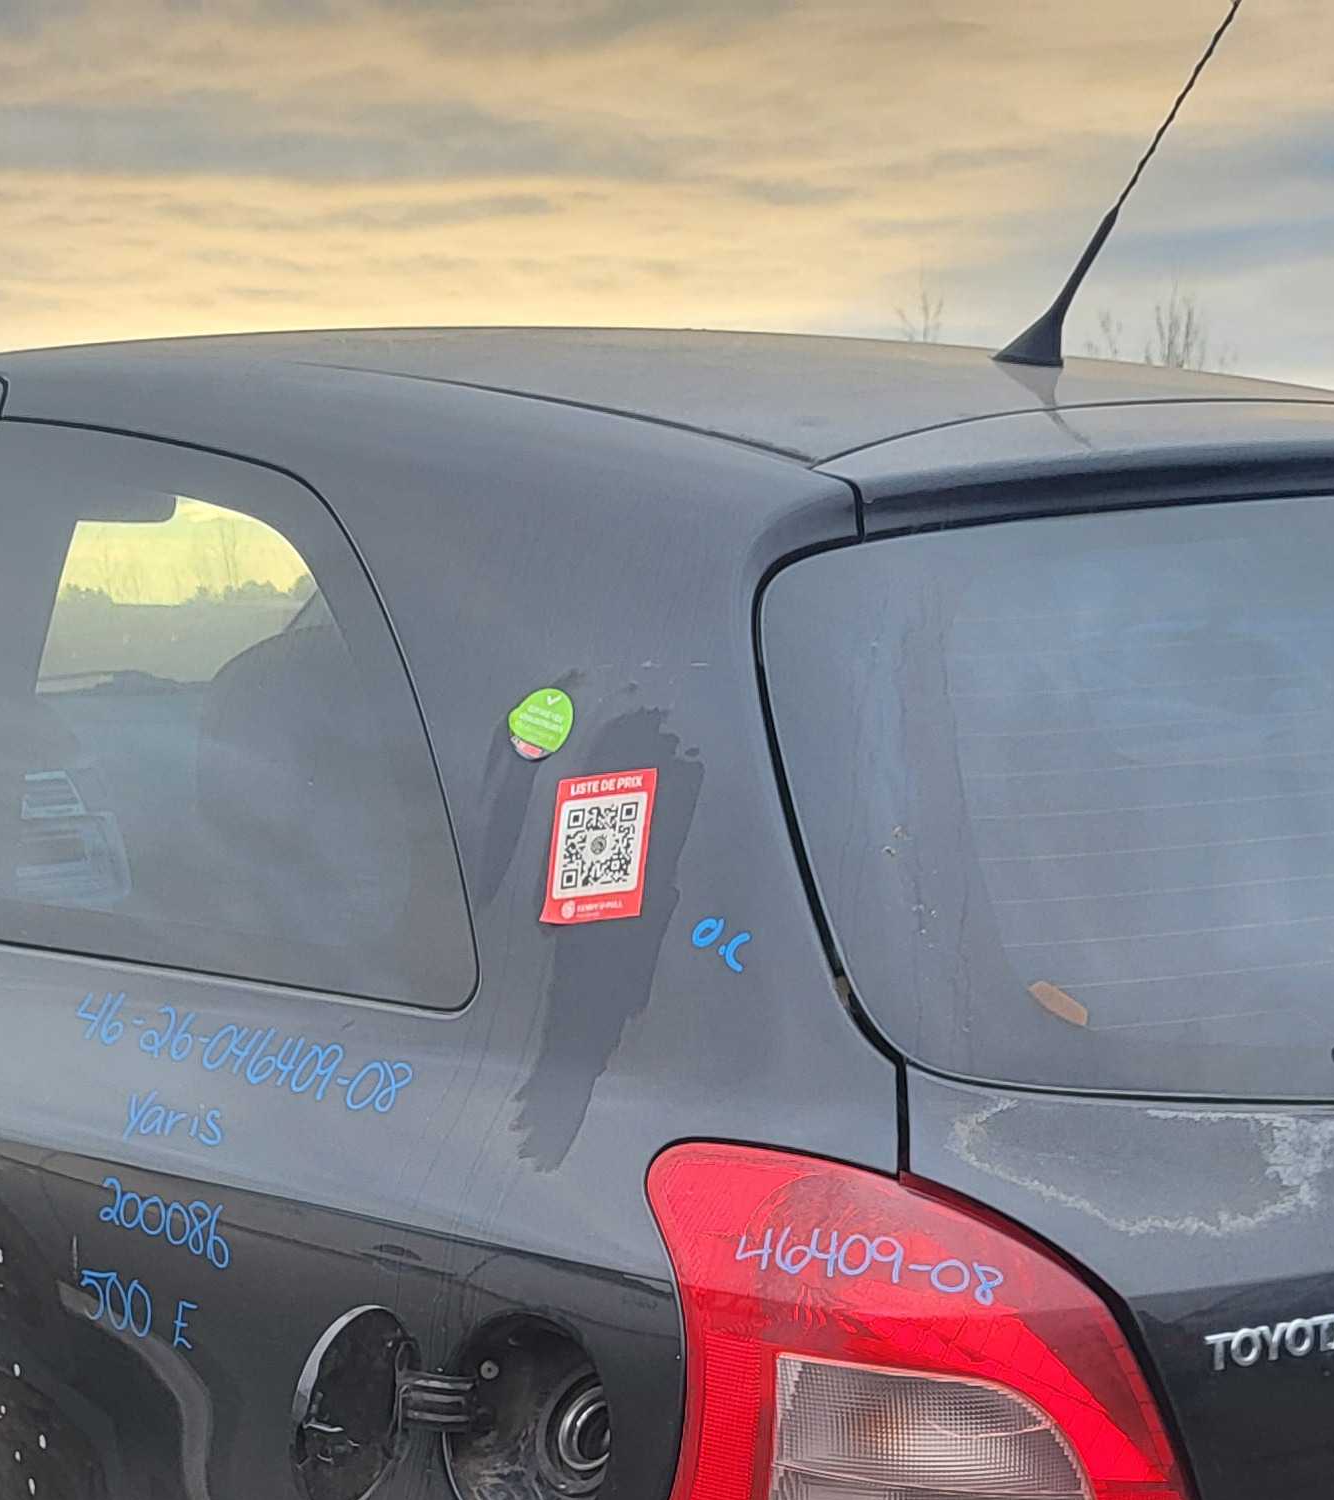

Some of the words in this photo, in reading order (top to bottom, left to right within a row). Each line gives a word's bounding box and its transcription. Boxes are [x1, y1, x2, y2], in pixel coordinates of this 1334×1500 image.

[570, 782, 600, 796] LISTE
[600, 779, 616, 793] DE
[617, 775, 643, 789] PRIX
[76, 992, 413, 1113] 46-26-046409-08
[99, 1176, 231, 1269] 200086
[734, 1228, 1004, 1304] 46409-08
[173, 1300, 199, 1349] E
